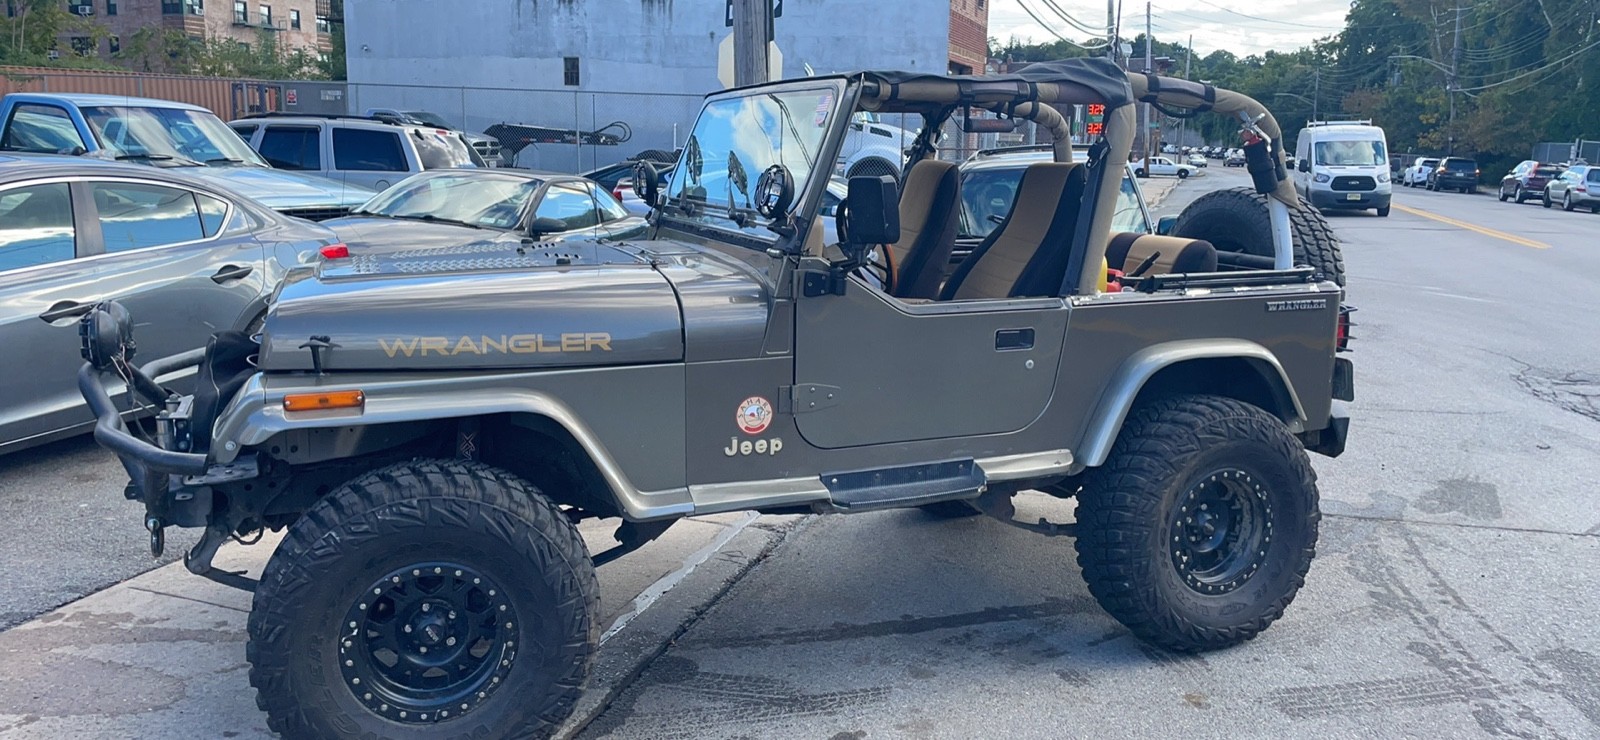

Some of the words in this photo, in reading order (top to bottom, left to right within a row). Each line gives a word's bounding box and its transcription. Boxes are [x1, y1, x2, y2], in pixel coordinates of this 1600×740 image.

[1266, 300, 1327, 312] WRANGLER
[377, 332, 613, 358] WRANGLER
[738, 398, 771, 418] SAHARA
[724, 436, 783, 456] Jeep
